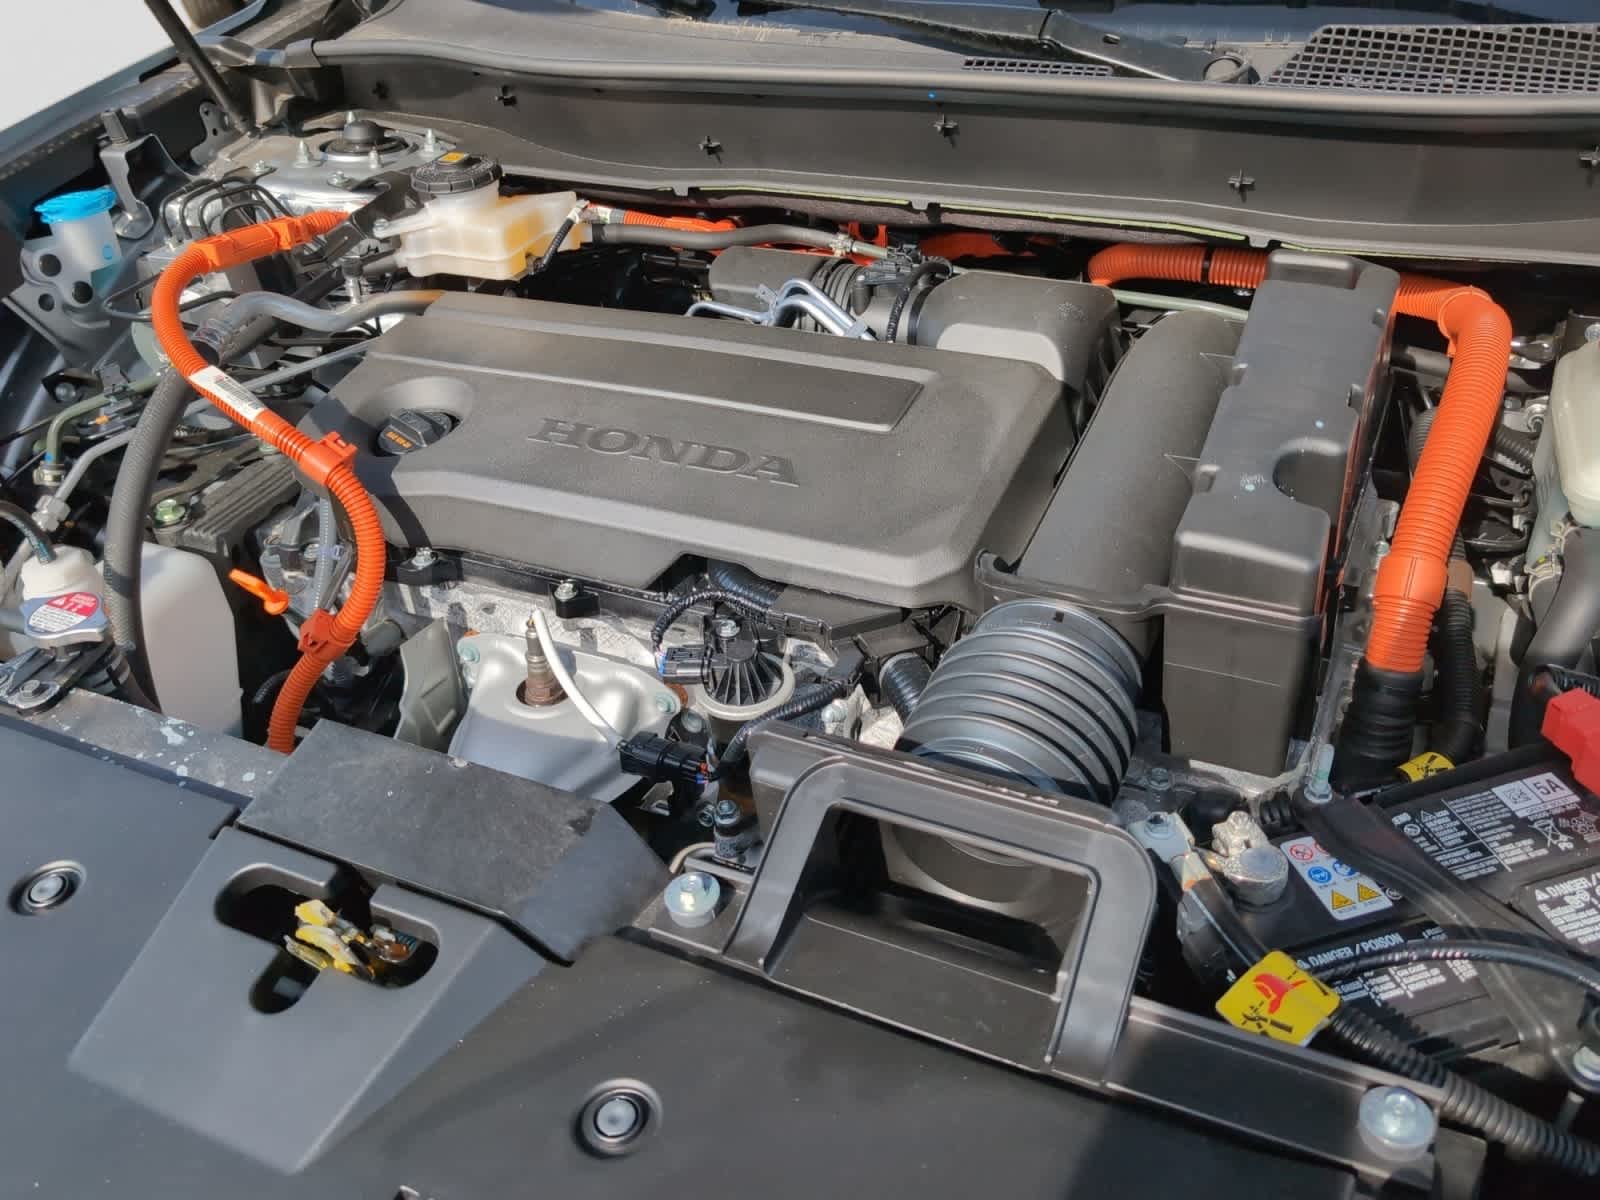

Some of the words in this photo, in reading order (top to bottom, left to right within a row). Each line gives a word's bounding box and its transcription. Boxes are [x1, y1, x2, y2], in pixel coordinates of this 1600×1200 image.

[527, 417, 800, 488] HONDA
[1532, 779, 1565, 796] 5A
[1545, 876, 1593, 898] DANGER
[1307, 946, 1353, 968] DANGER
[1360, 932, 1404, 953] POISON
